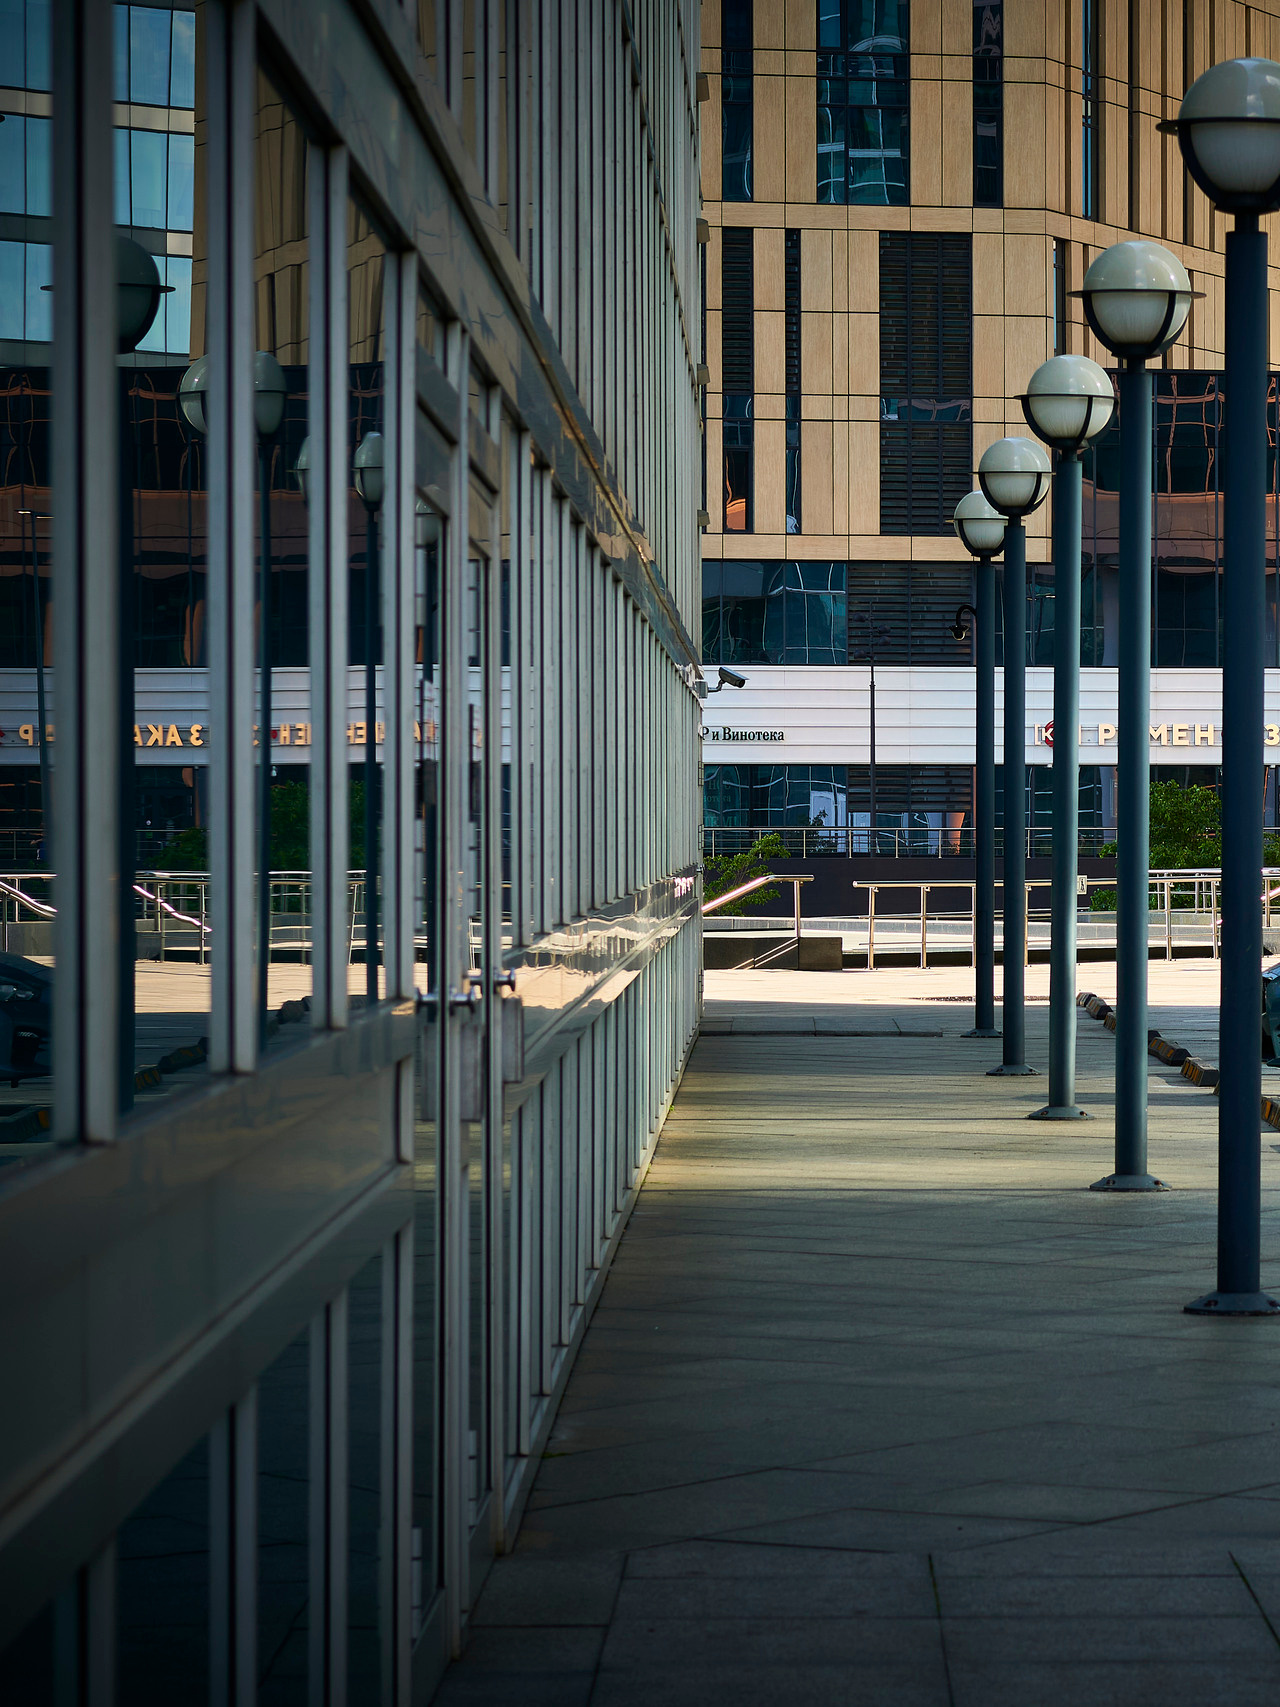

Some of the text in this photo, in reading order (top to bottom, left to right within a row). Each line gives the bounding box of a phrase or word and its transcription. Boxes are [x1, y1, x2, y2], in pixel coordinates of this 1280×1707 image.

[712, 731, 719, 740] и
[722, 726, 784, 740] Винотека
[1099, 724, 1213, 745] РМЕН
